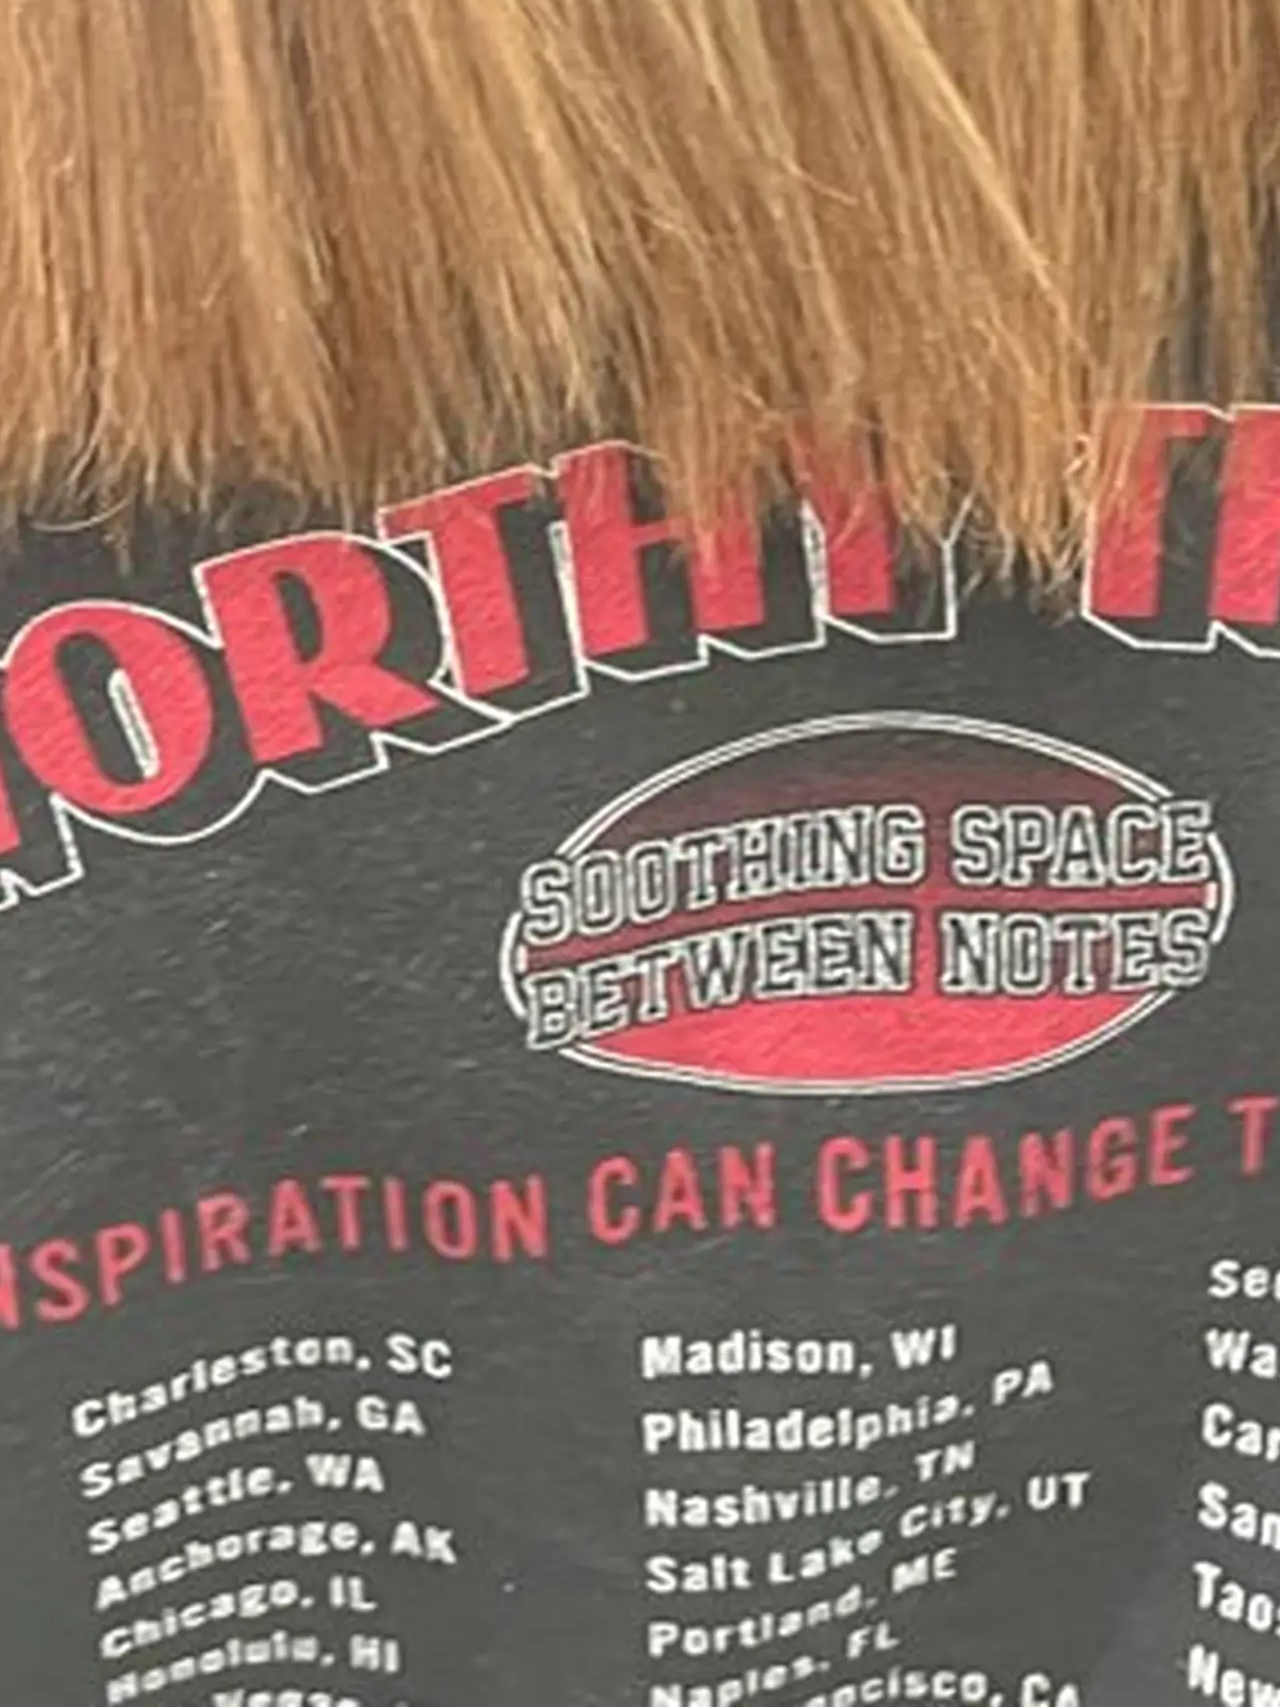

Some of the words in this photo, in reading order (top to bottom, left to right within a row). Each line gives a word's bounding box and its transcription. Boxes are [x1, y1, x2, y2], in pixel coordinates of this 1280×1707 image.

[521, 803, 925, 946] SOOTHING
[951, 798, 1213, 888] SPACE
[524, 911, 915, 1050] BETWEEN
[939, 907, 1213, 997] NOTES
[586, 1141, 776, 1244] CAN
[815, 1104, 1197, 1232] CHANGE
[386, 1334, 452, 1378] SC
[641, 1329, 874, 1379] Madison,
[891, 1324, 957, 1370] WI
[991, 1360, 1054, 1405] PA
[356, 1395, 426, 1436] GA
[306, 1454, 385, 1492] WA
[915, 1441, 975, 1481] TN
[390, 1521, 456, 1563] AK
[645, 1553, 751, 1593] Salt
[768, 1529, 882, 1584] Lake
[1027, 1471, 1092, 1509] UT
[892, 1547, 958, 1593] ME
[329, 1575, 377, 1611] IL
[350, 1634, 400, 1672] HI
[846, 1620, 901, 1659] FL
